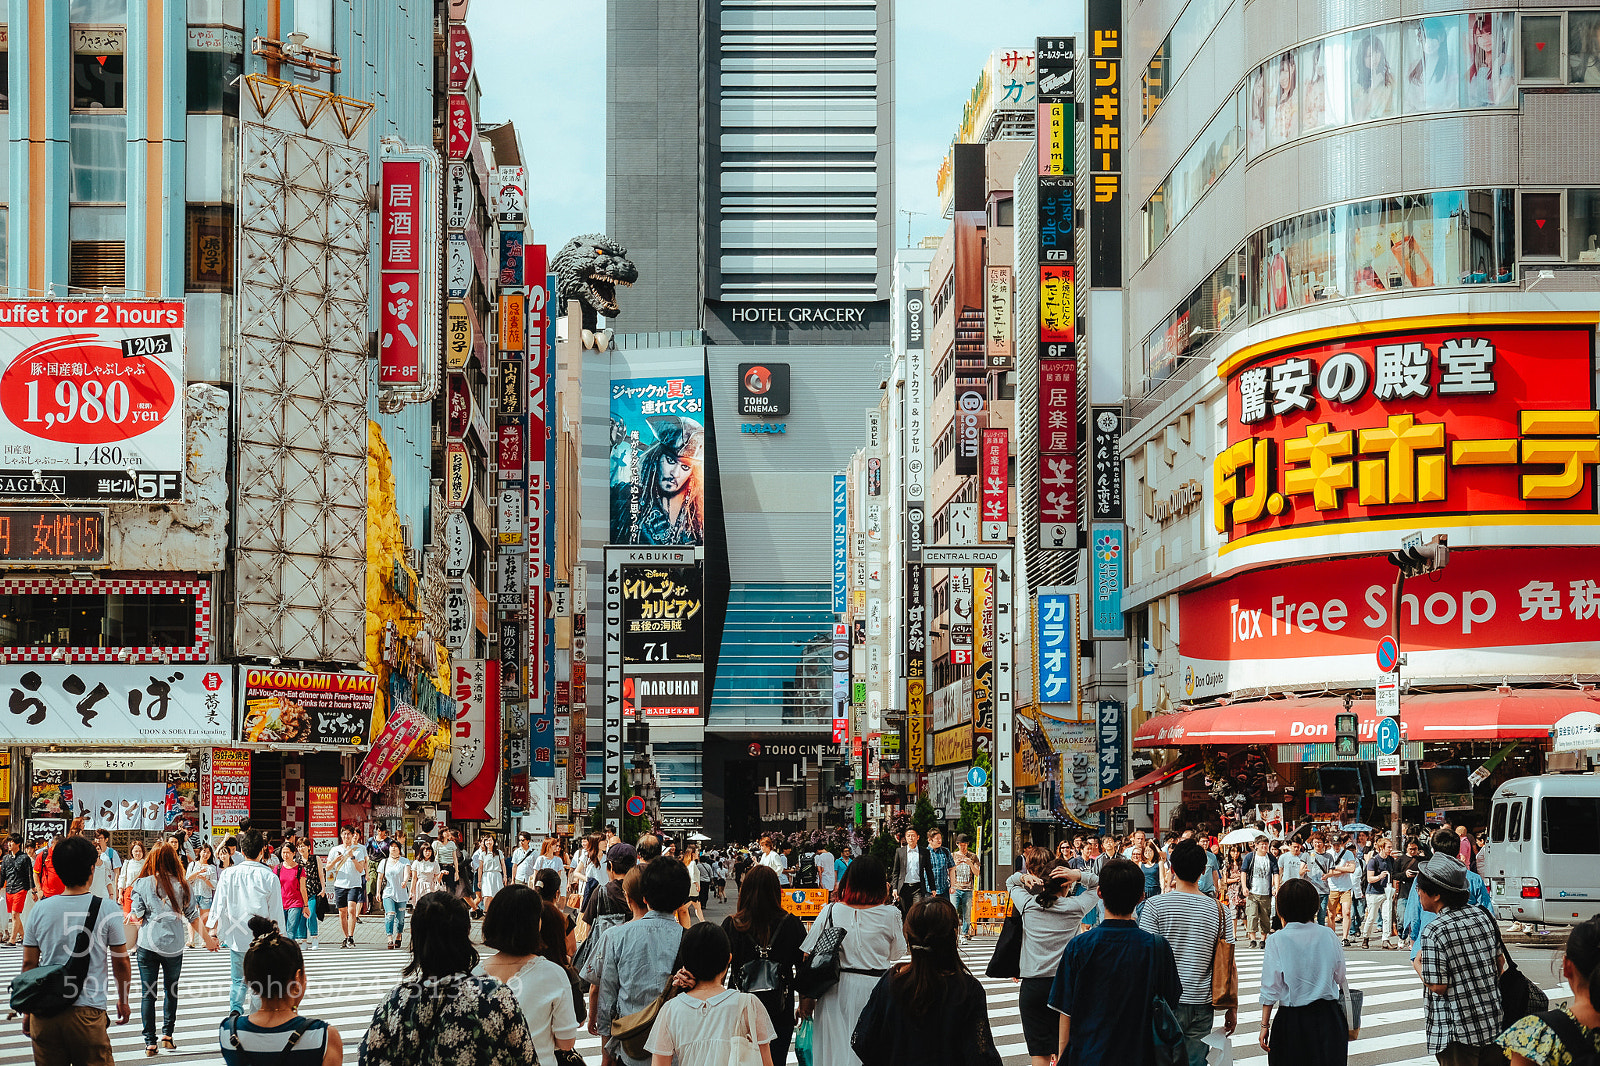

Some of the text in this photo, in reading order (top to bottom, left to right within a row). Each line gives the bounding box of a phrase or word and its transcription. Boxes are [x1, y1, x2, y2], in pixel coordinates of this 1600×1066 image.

[189, 31, 214, 39] しゃぶ
[197, 39, 221, 47] しゃぶ
[452, 41, 470, 73] つぼ八
[451, 109, 469, 142] つぼ八
[1040, 179, 1074, 187] New Club
[388, 184, 412, 263] 居酒屋
[450, 217, 465, 226] 6F
[202, 237, 220, 268] 虎の子
[56, 304, 87, 324] for
[95, 305, 109, 324] 2
[116, 305, 178, 324] hours
[382, 281, 418, 348] つぼ八
[732, 307, 867, 323] HOTEL GRACERY
[450, 320, 467, 353] 虎の子
[125, 337, 169, 358] 120分
[1048, 344, 1067, 356] 6F
[30, 362, 146, 377] 豚・国産鶏しゃぶしゃぶ
[993, 356, 1007, 365] 6F
[503, 362, 517, 407] 山内農場
[1046, 373, 1070, 382] 居酒屋
[1239, 338, 1496, 425] 驚安の殿堂
[612, 379, 693, 400] ジャックが夏を
[23, 380, 130, 430] 1,980
[641, 398, 702, 415] 連れてくる!
[743, 405, 778, 413] CINEMAS
[744, 396, 769, 405] TOHO
[911, 354, 920, 453] ネットカフェ & カプセル
[132, 410, 159, 424] yen
[959, 391, 984, 458] Booth
[1048, 388, 1068, 450] 居楽屋
[741, 423, 787, 434] IMAX
[4, 444, 32, 455] 国産鶏
[73, 446, 123, 467] 1,480
[4, 455, 70, 465] しゃぶしゃぶコース
[122, 455, 143, 467] yen
[990, 446, 999, 475] 居楽屋
[452, 453, 463, 500] お好み焼き
[1096, 434, 1110, 514] かんかん商店
[98, 474, 177, 498] 当ビル 5F
[1153, 482, 1196, 523] Don Quijote
[453, 525, 463, 567] とらそば
[504, 533, 517, 543] 3F
[834, 480, 846, 608] 747 カラオケランド
[927, 552, 999, 560] CENTRAL ROAD
[450, 569, 461, 577] 1F
[1099, 563, 1109, 601] STAGE
[1108, 563, 1118, 594] IDOL
[500, 594, 521, 603] 大阪家
[641, 598, 701, 620] カリビアン
[1230, 578, 1600, 643] Tax Free Shop 免税
[630, 620, 683, 632] 最後の海賊
[907, 604, 925, 653] 甘太郎
[643, 642, 670, 662] 7.1
[1043, 598, 1067, 698] カラオケ
[909, 668, 923, 677] 3F
[910, 659, 923, 668] 4F
[247, 670, 377, 693] OKONOMI YAKI
[474, 661, 483, 703] 大衆酒場
[606, 587, 620, 775] GODZILLA ROAD
[641, 680, 699, 696] MARUHAN
[1194, 671, 1224, 689] Don Quijote
[8, 670, 185, 728] らそば
[247, 688, 298, 698] All-You-Can-Eat
[333, 693, 374, 702] Free-Flowing
[297, 699, 317, 707] Drinks
[333, 701, 352, 709] hours
[455, 666, 472, 738] トラノコ
[200, 728, 227, 737] standing
[1290, 721, 1328, 738] Don
[764, 745, 797, 756] TOHO
[1101, 705, 1120, 785] カラオケ
[106, 760, 135, 768] とらそば
